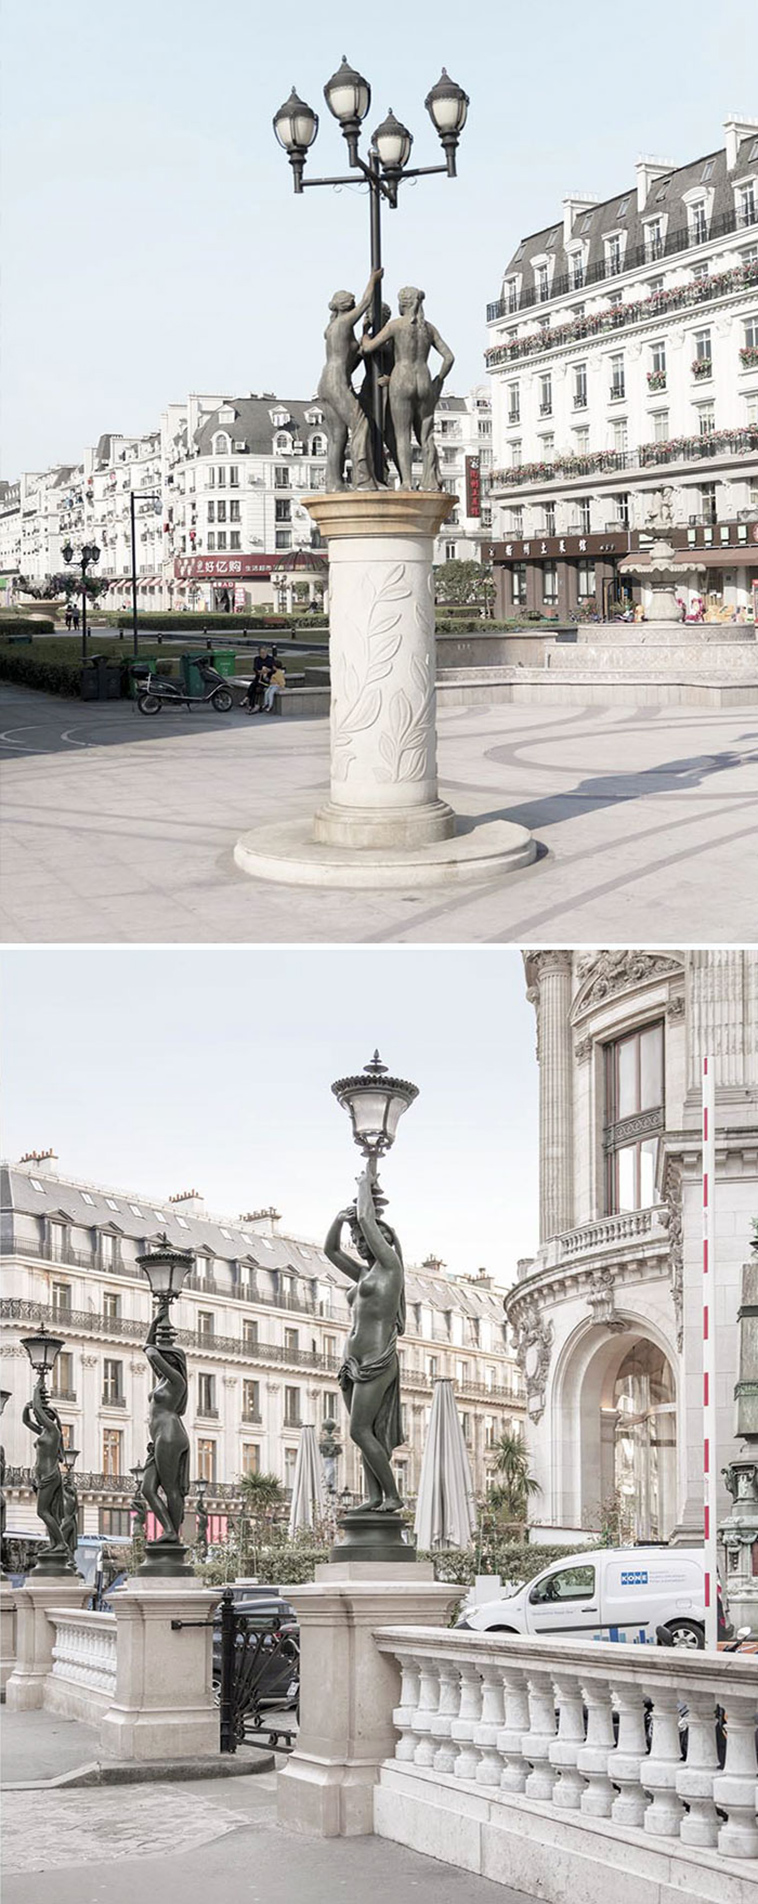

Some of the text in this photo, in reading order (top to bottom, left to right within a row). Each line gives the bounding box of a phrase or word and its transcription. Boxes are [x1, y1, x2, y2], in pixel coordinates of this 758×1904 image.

[204, 560, 243, 573] 好亿购
[621, 1573, 648, 1584] KONE
